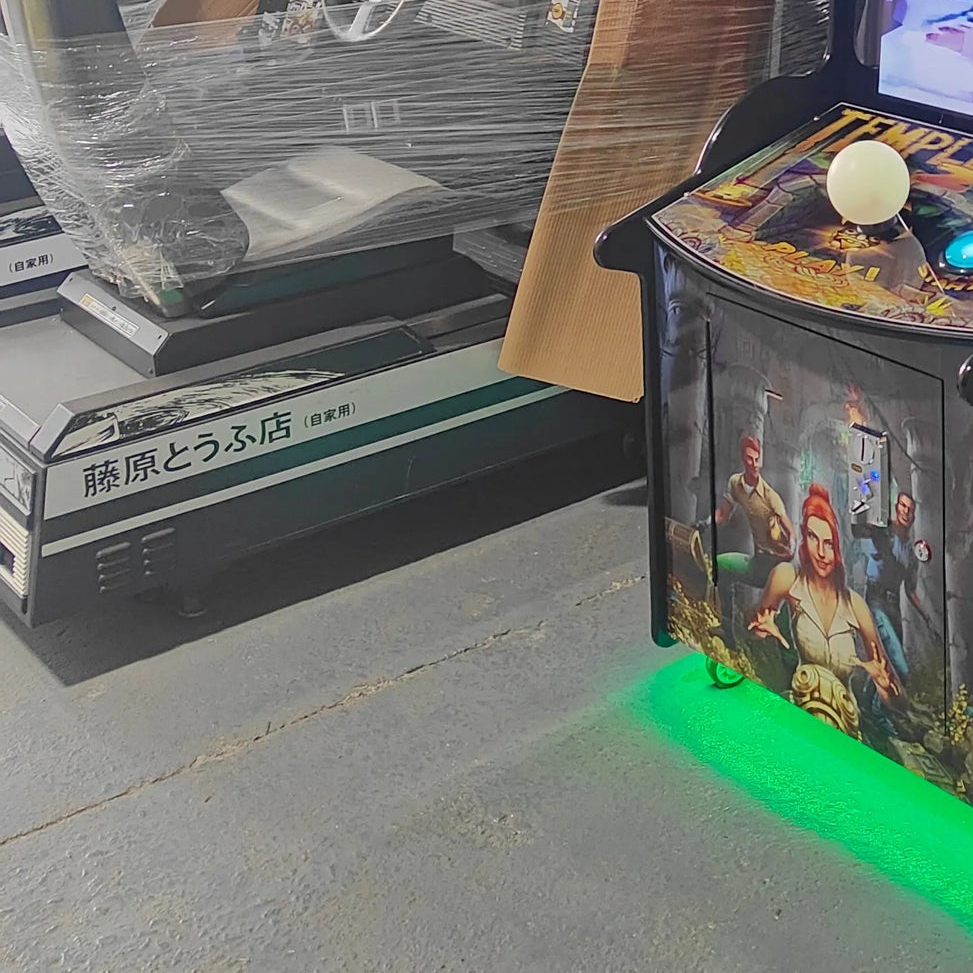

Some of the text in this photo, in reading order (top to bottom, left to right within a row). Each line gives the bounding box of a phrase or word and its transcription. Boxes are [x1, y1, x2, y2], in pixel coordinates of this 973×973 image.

[82, 402, 357, 498] 藤原とうふ店 (自家用)
